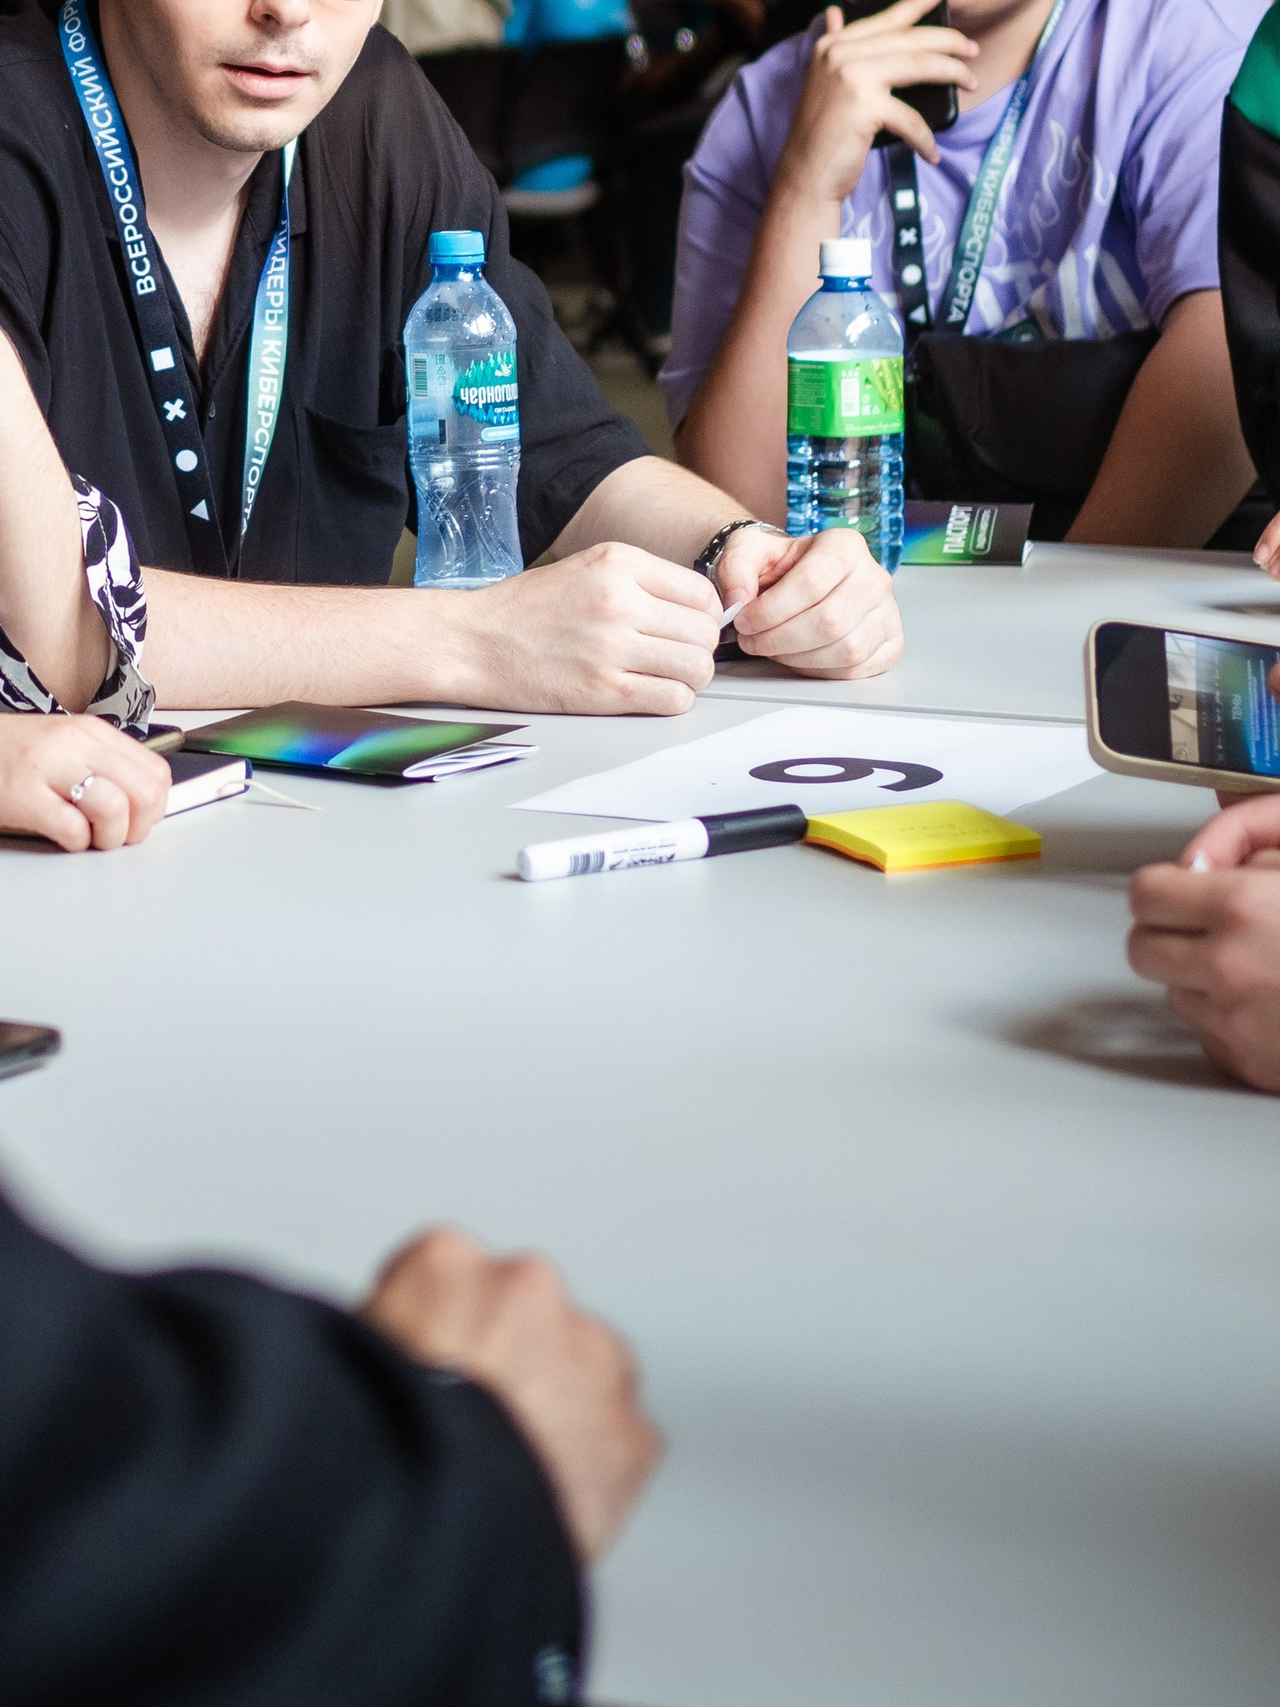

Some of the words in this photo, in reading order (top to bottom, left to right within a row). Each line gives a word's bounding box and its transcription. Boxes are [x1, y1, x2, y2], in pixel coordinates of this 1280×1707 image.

[71, 56, 157, 295] ВСЕРОССИЙСКИЙ
[946, 168, 1003, 325] КИБЕРСПОРТА
[241, 339, 282, 536] КИБЕРСПОРТА
[943, 504, 973, 553] ПАСПОРТ
